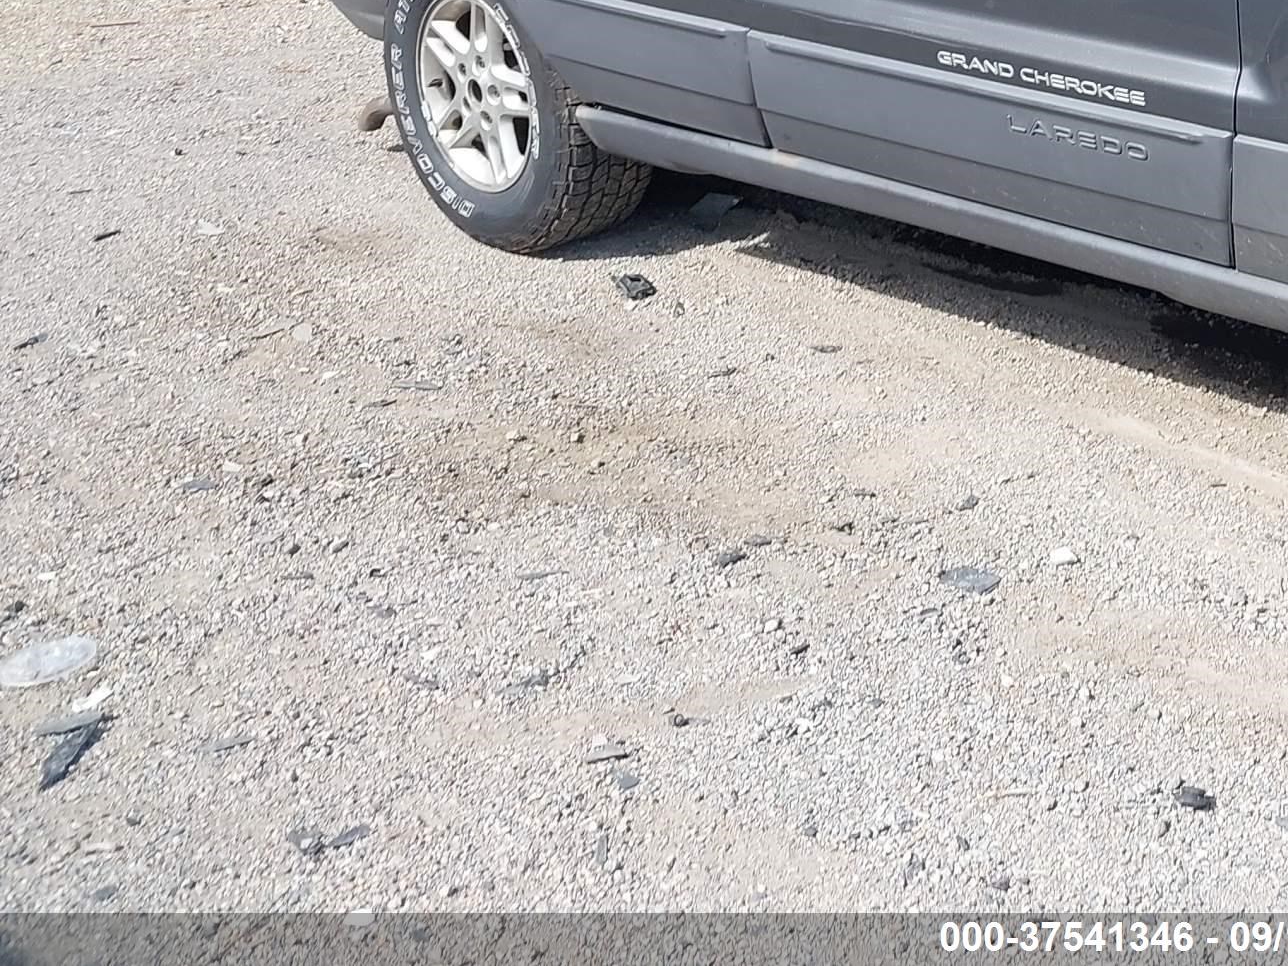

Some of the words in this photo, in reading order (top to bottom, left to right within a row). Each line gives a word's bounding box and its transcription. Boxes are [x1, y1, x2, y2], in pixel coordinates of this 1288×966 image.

[937, 50, 1014, 78] GRAND
[1020, 67, 1146, 106] CHEROKEE
[1006, 114, 1150, 161] LAREDO
